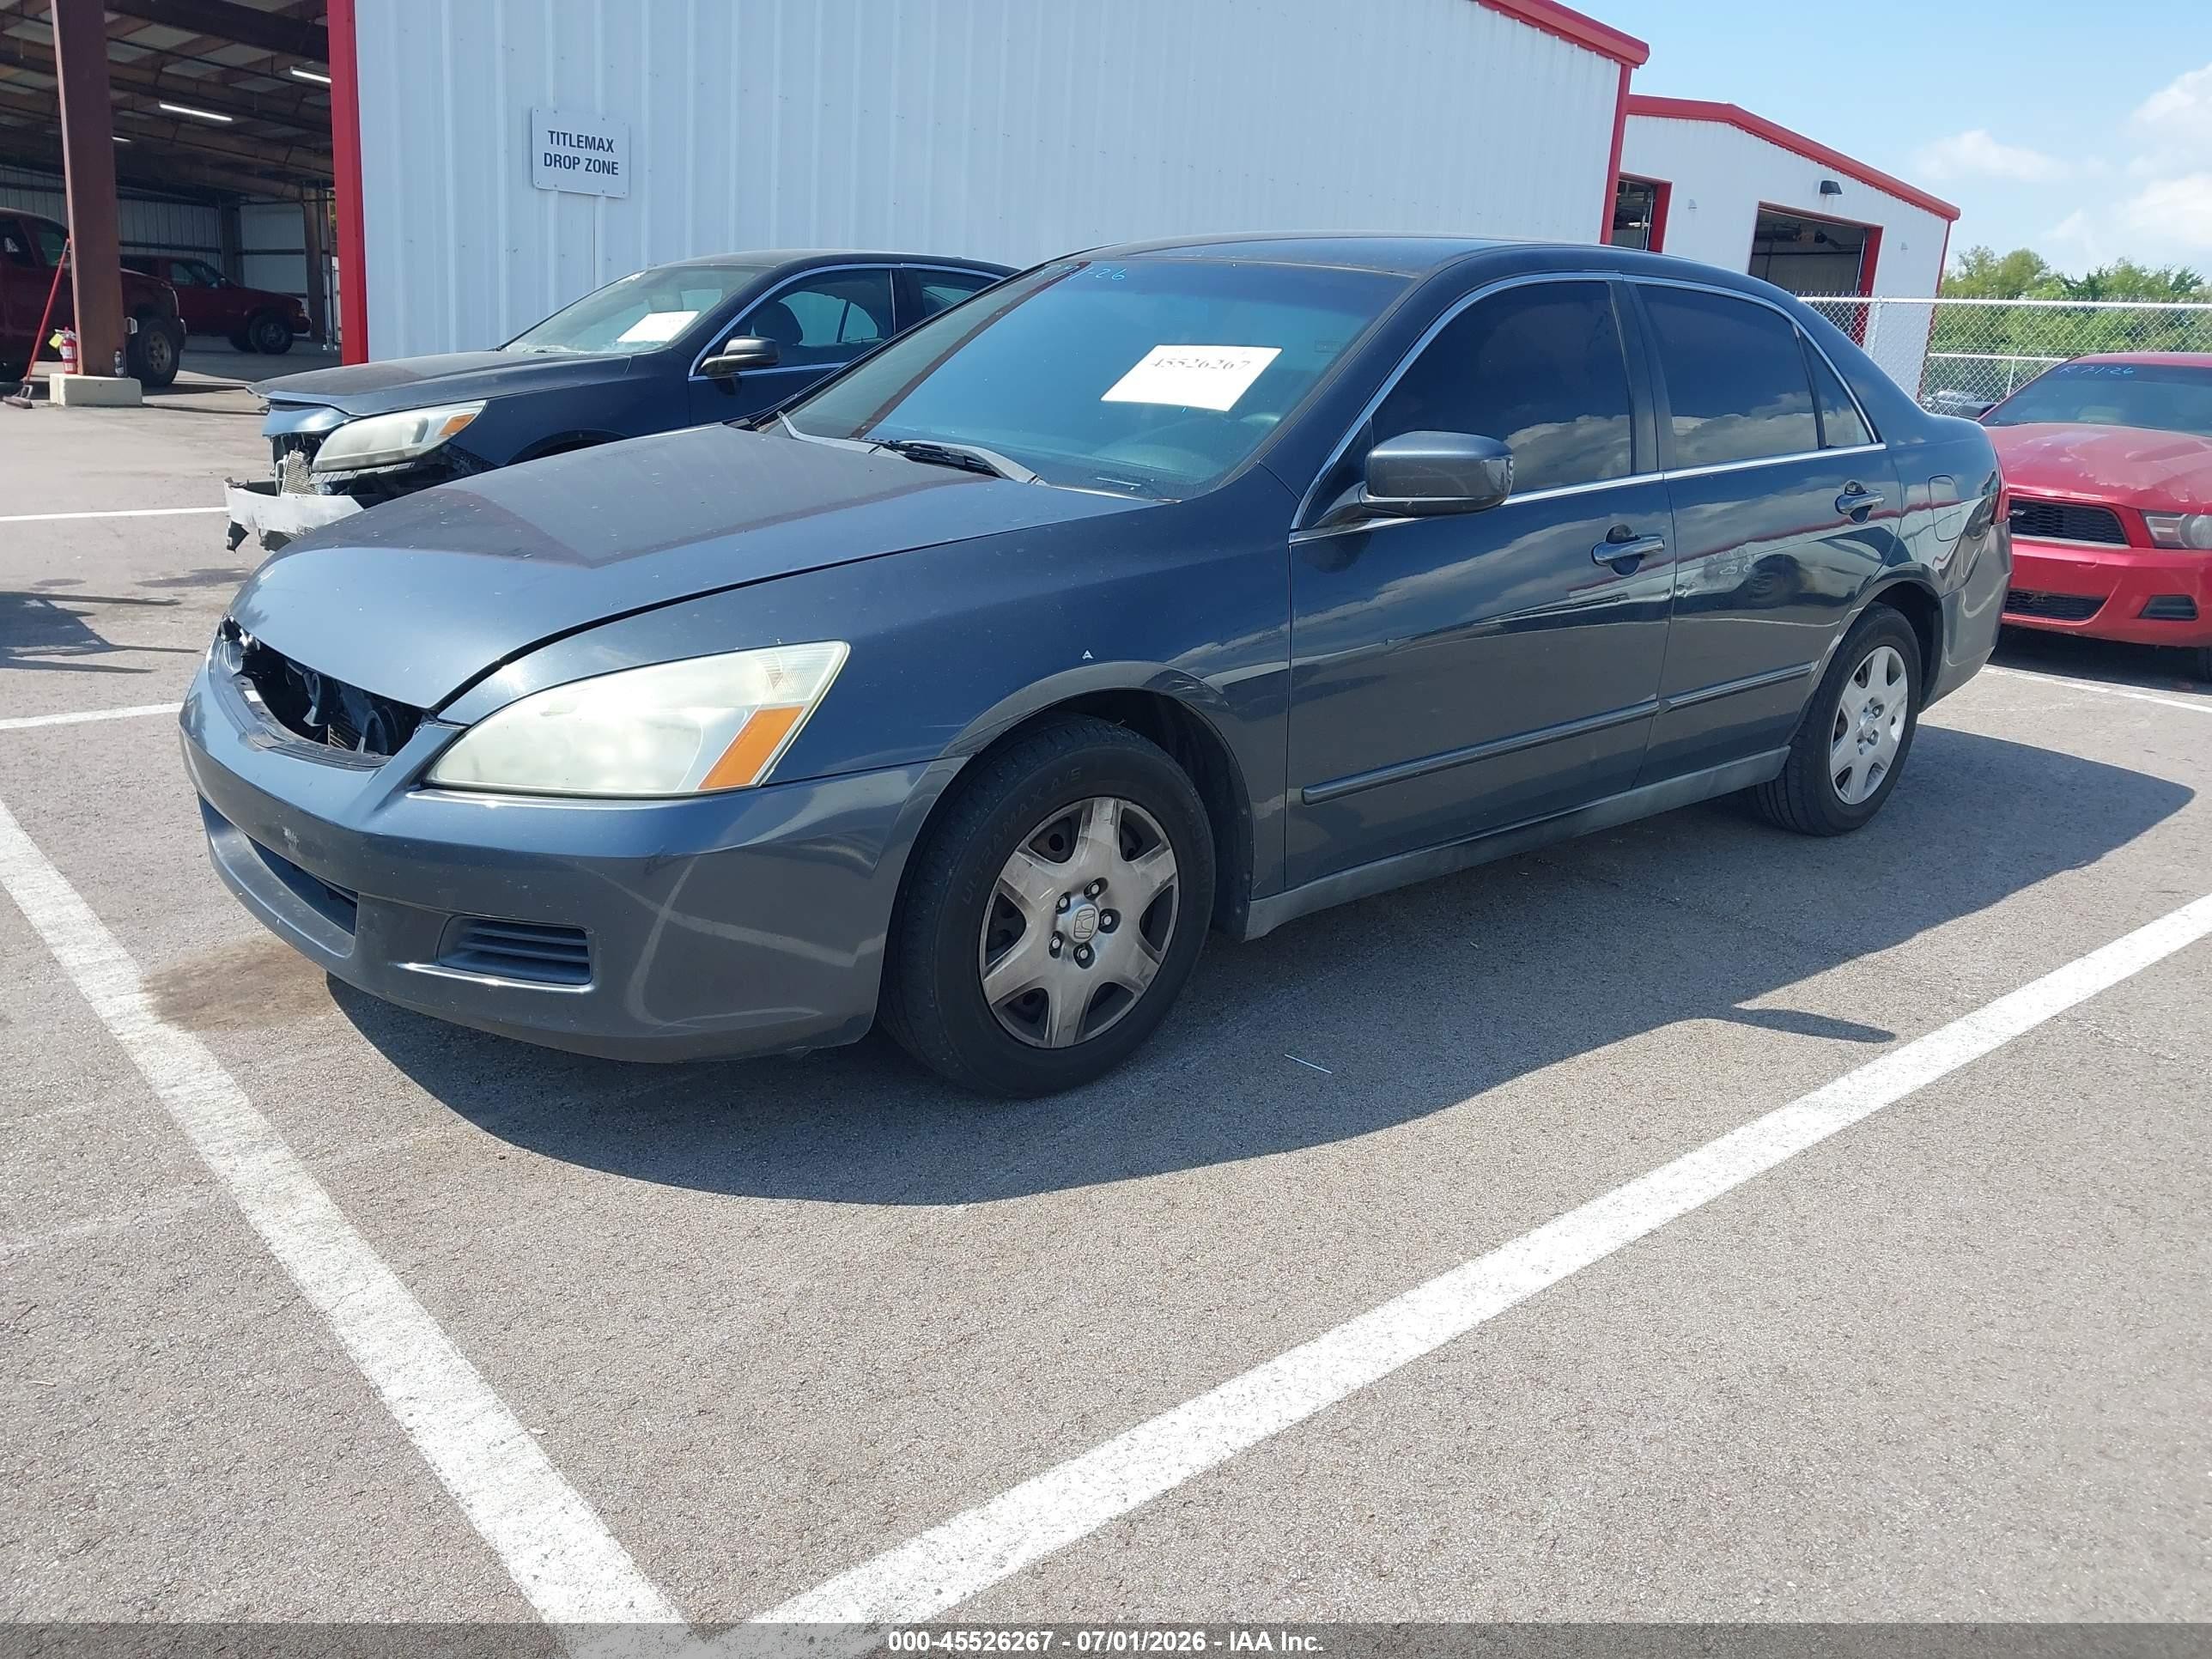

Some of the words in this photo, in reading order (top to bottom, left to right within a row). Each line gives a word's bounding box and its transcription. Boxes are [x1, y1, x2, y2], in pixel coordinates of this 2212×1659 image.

[548, 131, 614, 153] TITLEMAX
[544, 153, 580, 170] DROP
[585, 158, 618, 175] ZONE
